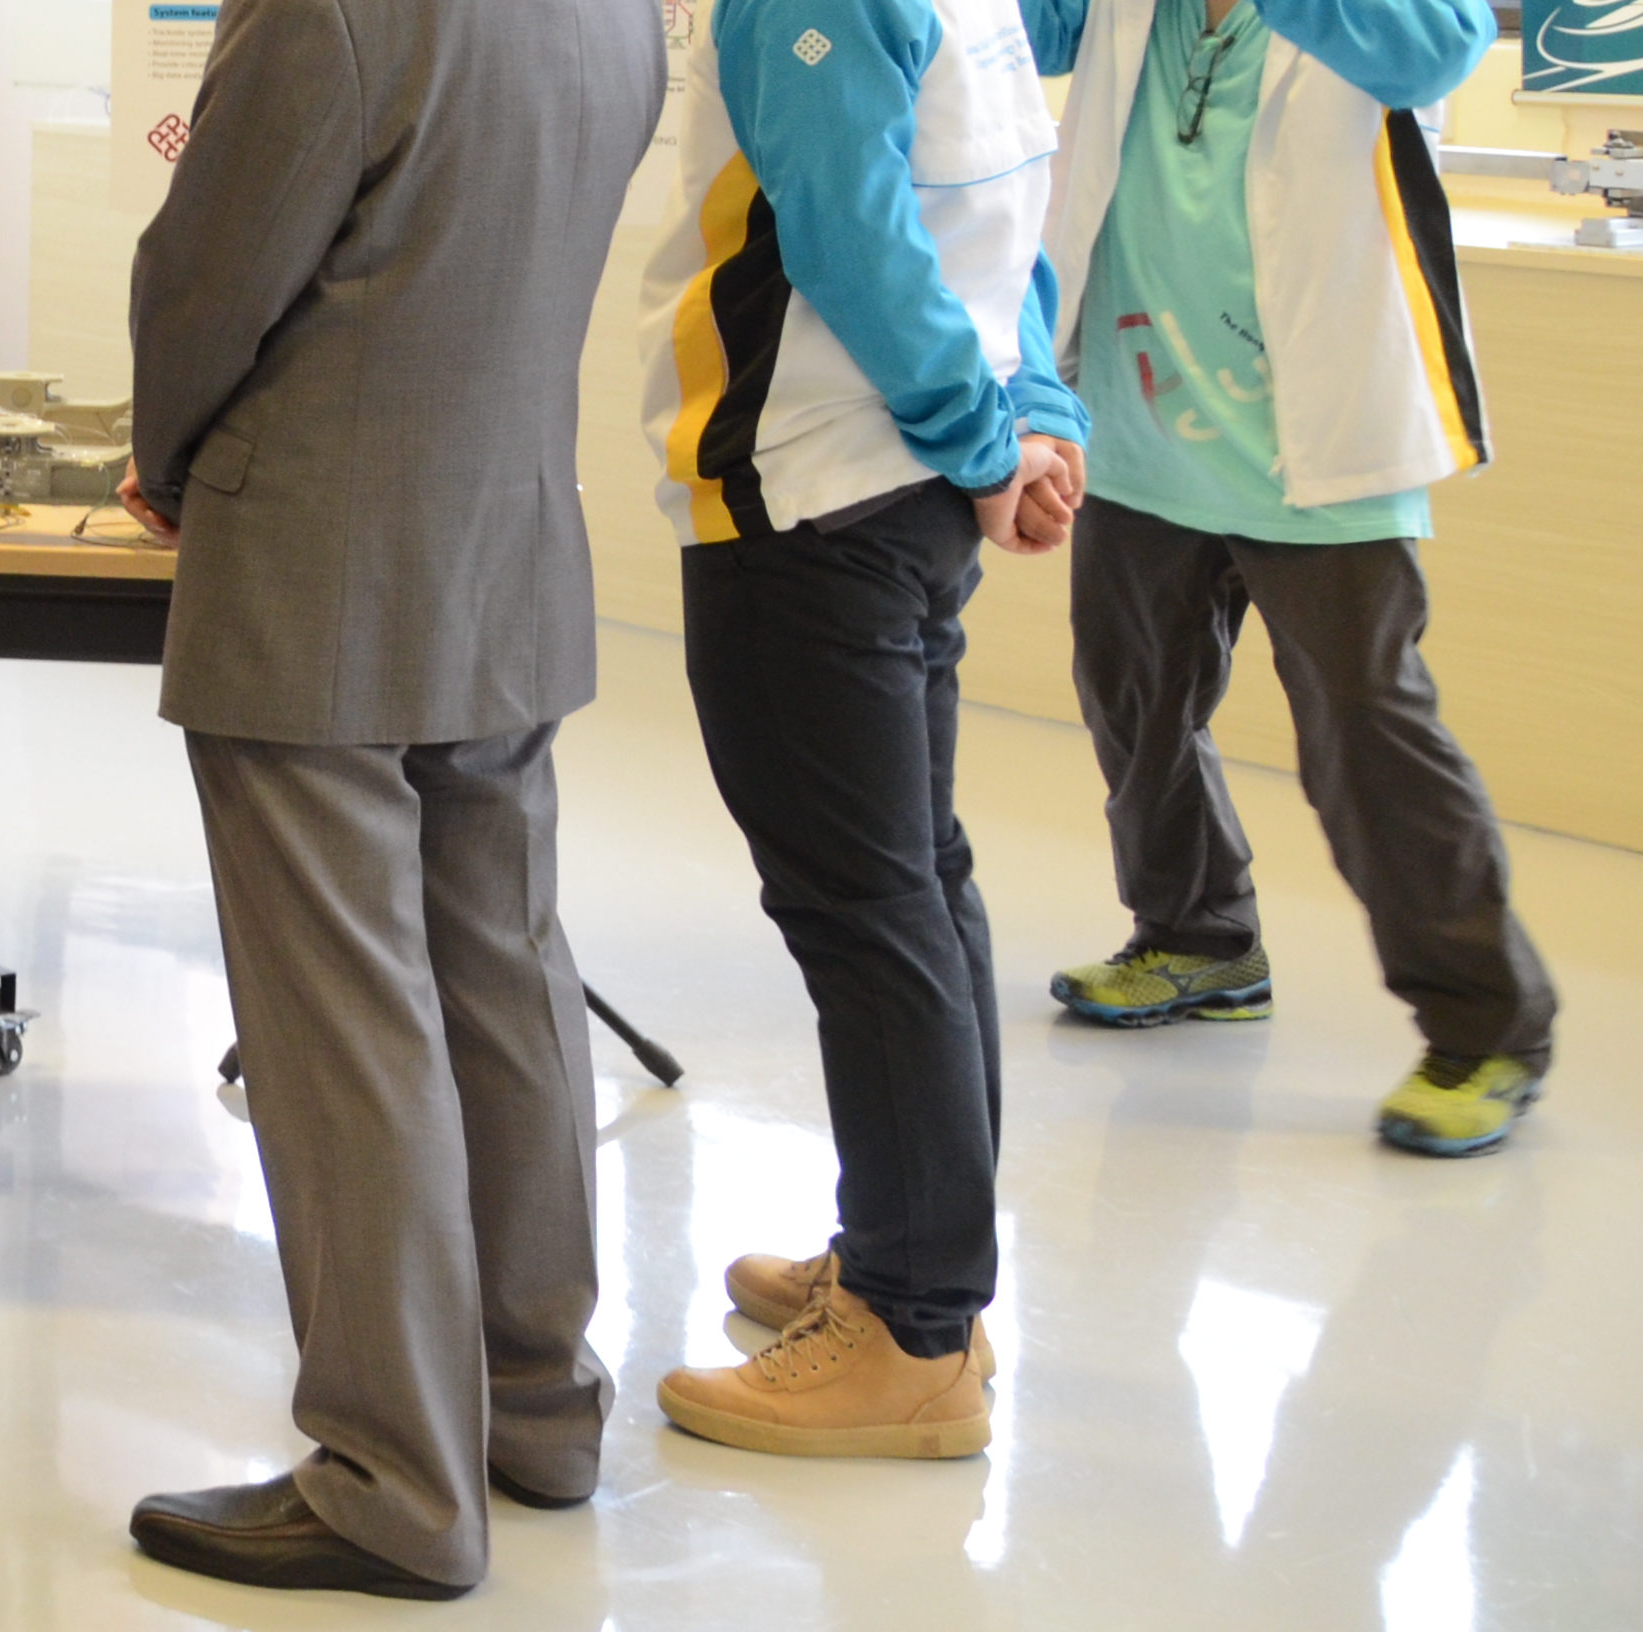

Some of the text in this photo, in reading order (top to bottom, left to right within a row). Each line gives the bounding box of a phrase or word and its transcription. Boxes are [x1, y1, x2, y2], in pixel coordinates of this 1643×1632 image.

[153, 7, 218, 18] System featu
[1220, 311, 1238, 330] The
